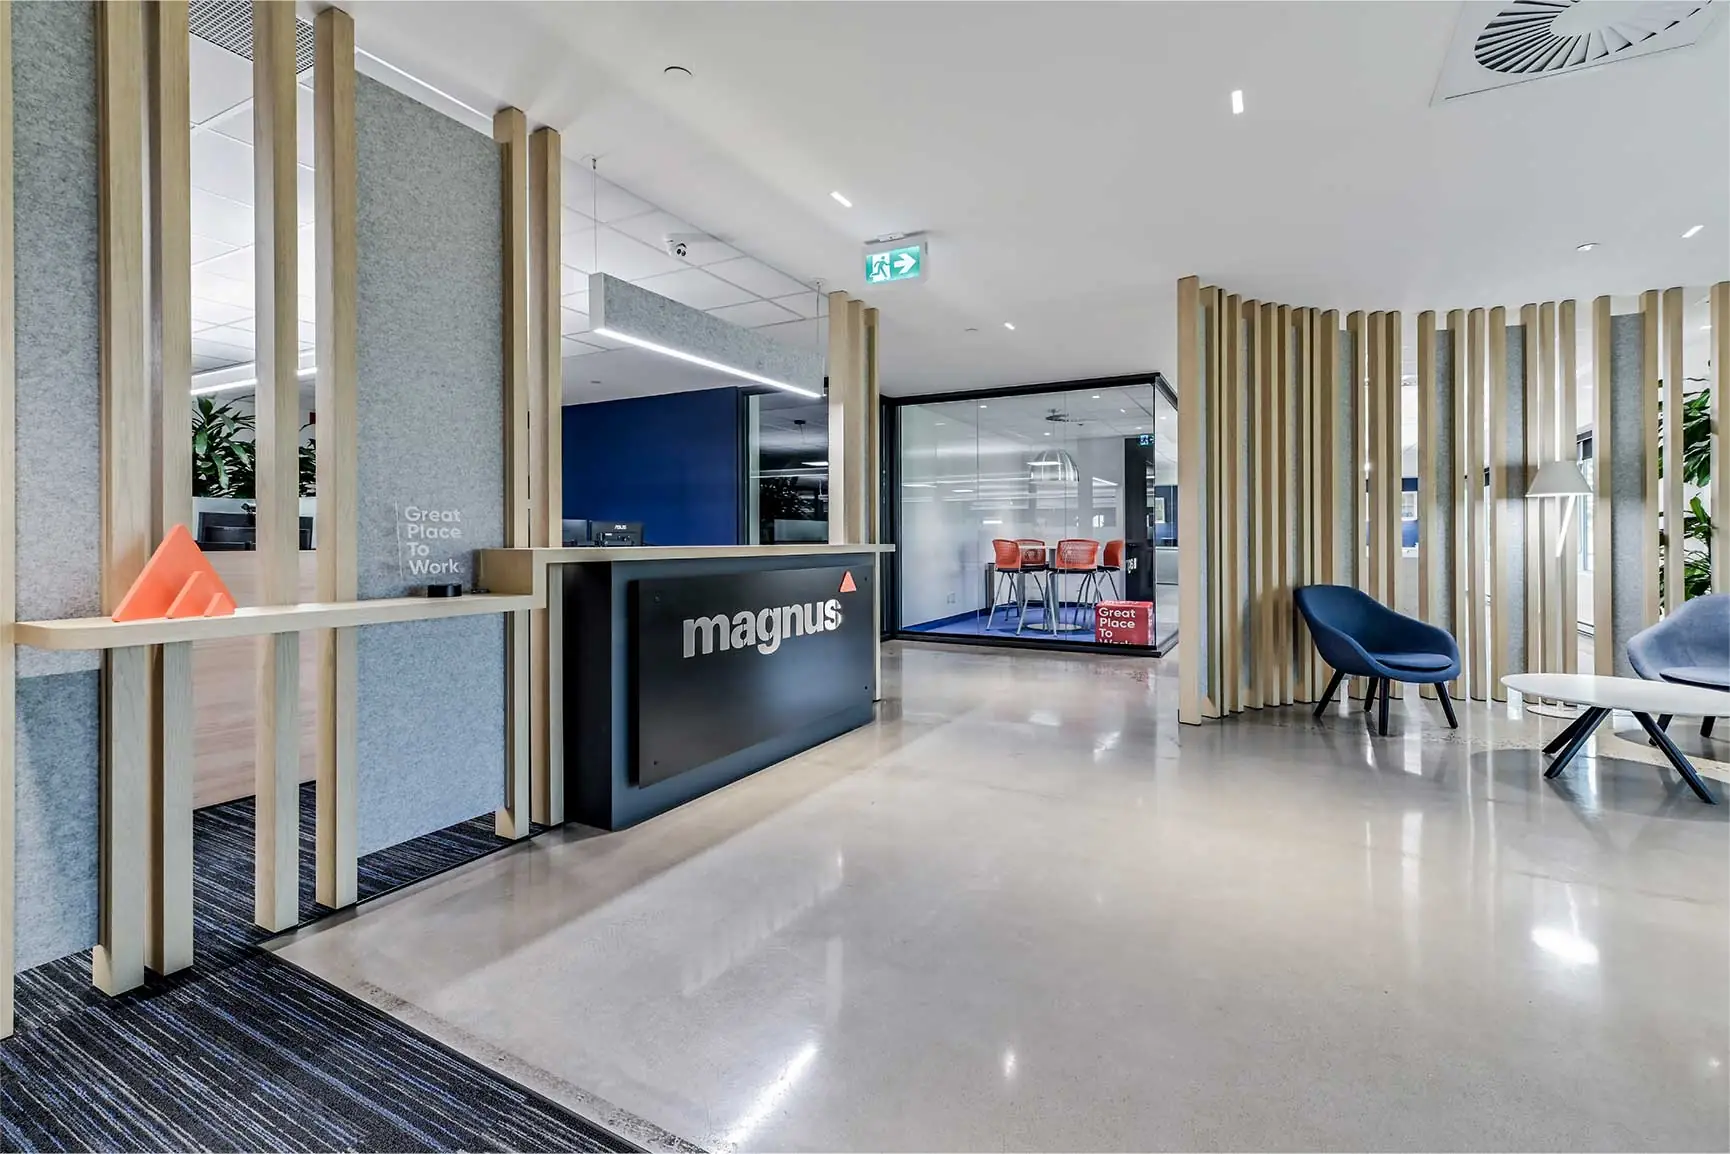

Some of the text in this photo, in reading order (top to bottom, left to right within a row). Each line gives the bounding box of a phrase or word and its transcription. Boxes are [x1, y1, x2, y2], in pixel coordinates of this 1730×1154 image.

[405, 506, 461, 522] Great
[408, 524, 462, 539] Place
[406, 541, 430, 556] To
[1098, 607, 1136, 618] Great
[682, 598, 842, 658] magnus
[1099, 617, 1136, 629] Place
[1098, 628, 1113, 638] To
